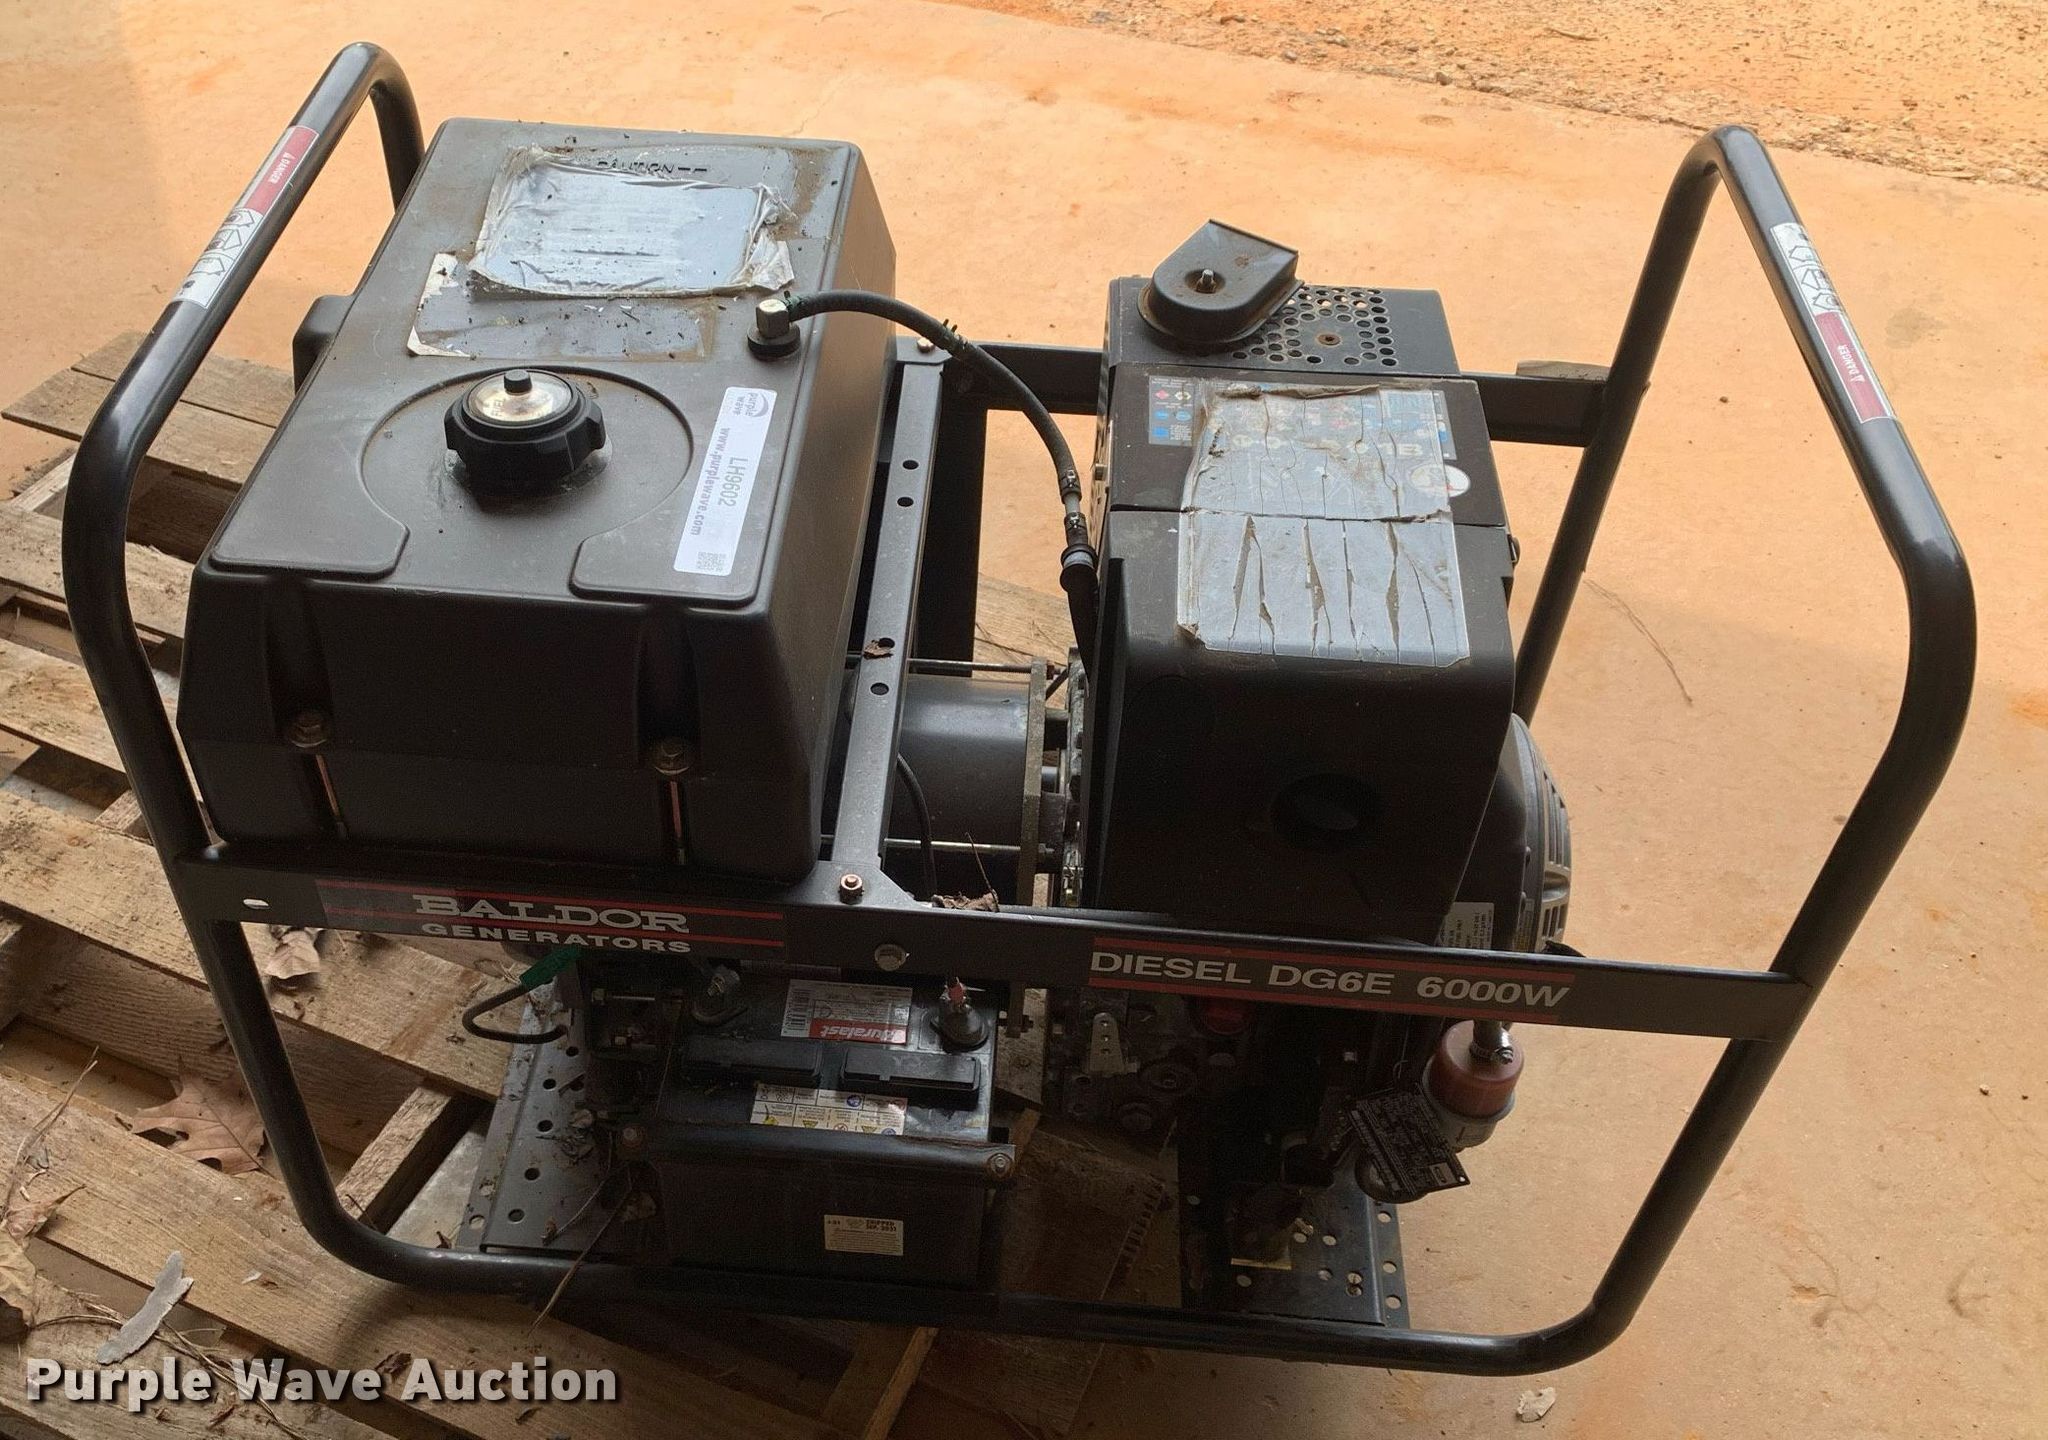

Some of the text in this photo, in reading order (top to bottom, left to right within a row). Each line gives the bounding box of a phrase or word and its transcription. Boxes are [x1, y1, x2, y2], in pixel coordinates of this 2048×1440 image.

[690, 427, 730, 536] www.purplewave.com
[718, 457, 748, 507] LH9602
[412, 894, 690, 934] BALDOR
[421, 923, 691, 953] GENERATORS
[1090, 952, 1569, 1008] DIESEL DG6E 6000W
